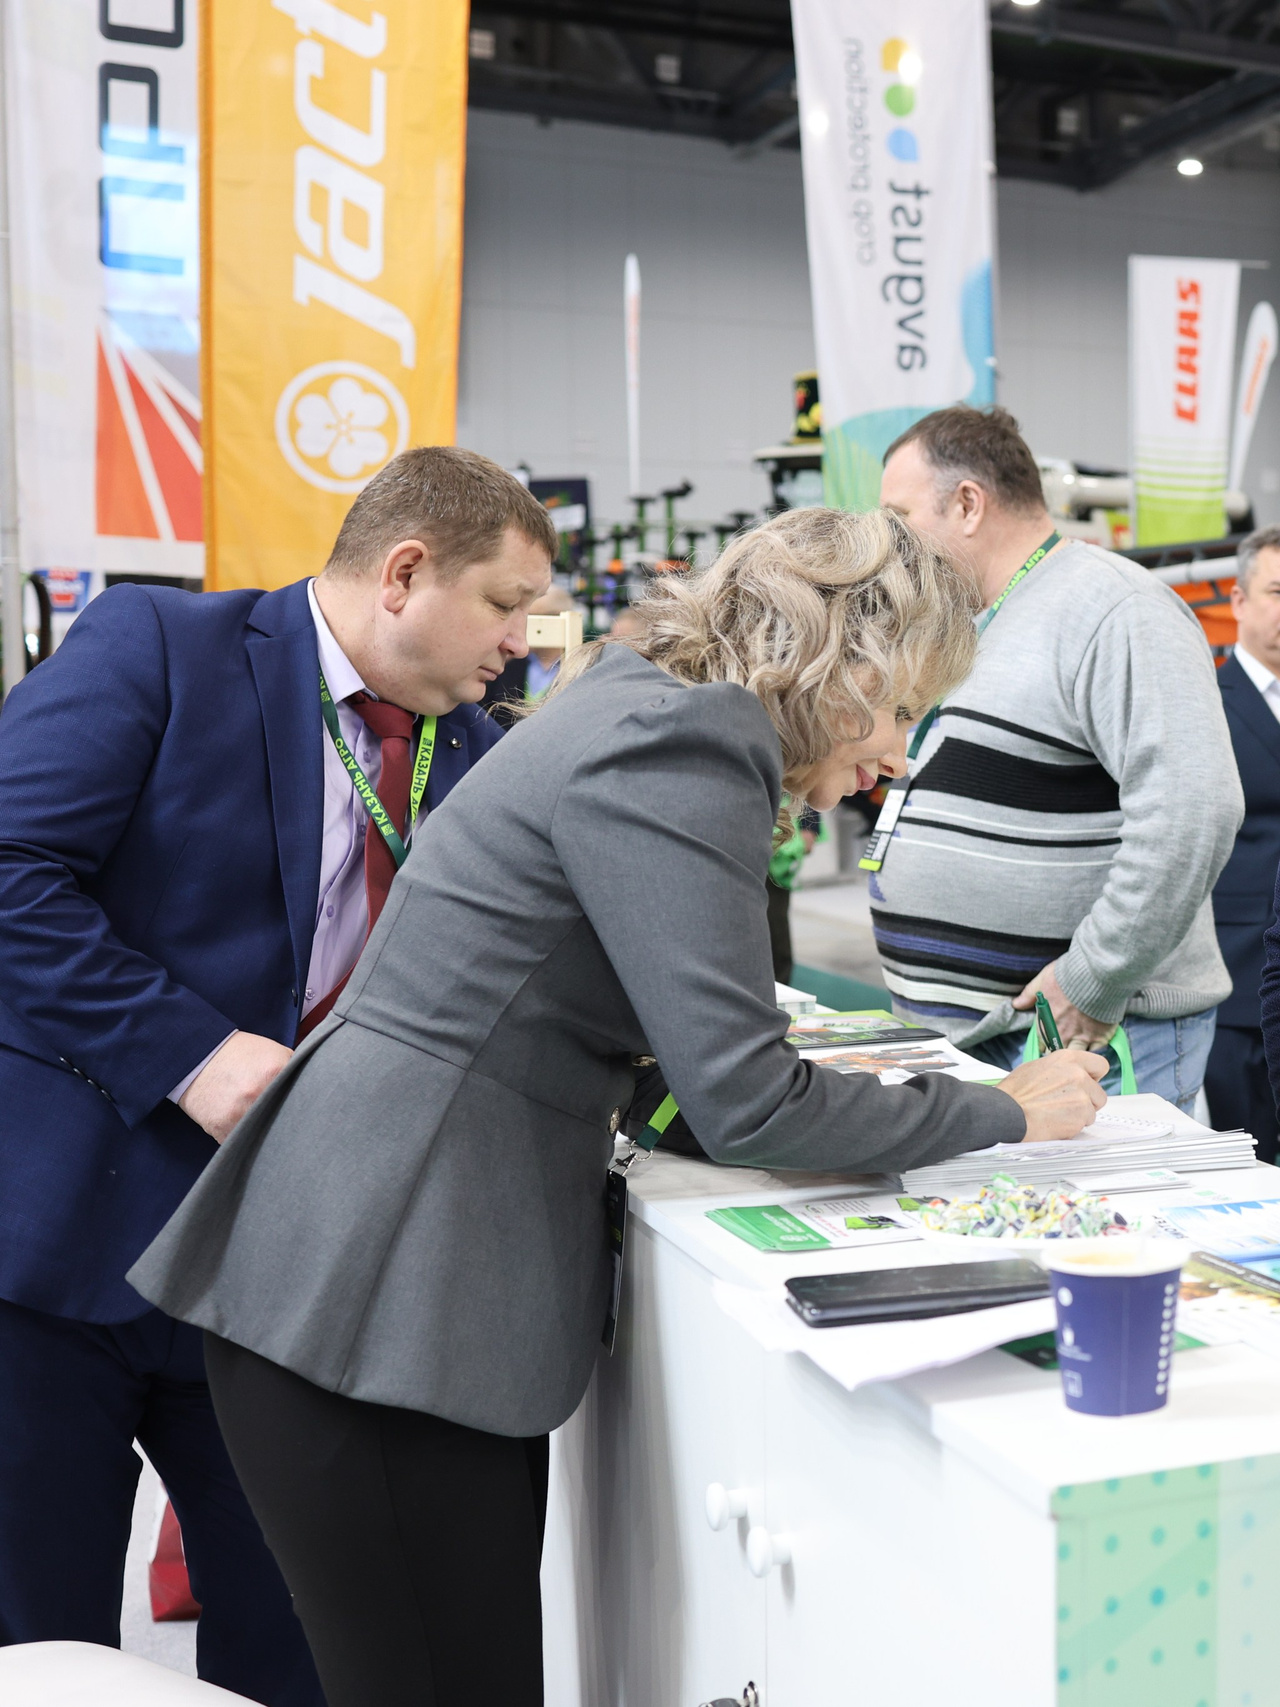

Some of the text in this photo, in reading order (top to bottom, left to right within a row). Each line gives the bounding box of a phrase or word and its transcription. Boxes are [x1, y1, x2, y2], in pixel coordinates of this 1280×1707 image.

[1174, 277, 1201, 424] CLAAS
[335, 737, 388, 825] КАЗАНЬ АГРО
[412, 747, 432, 793] КАЗАНЬ
